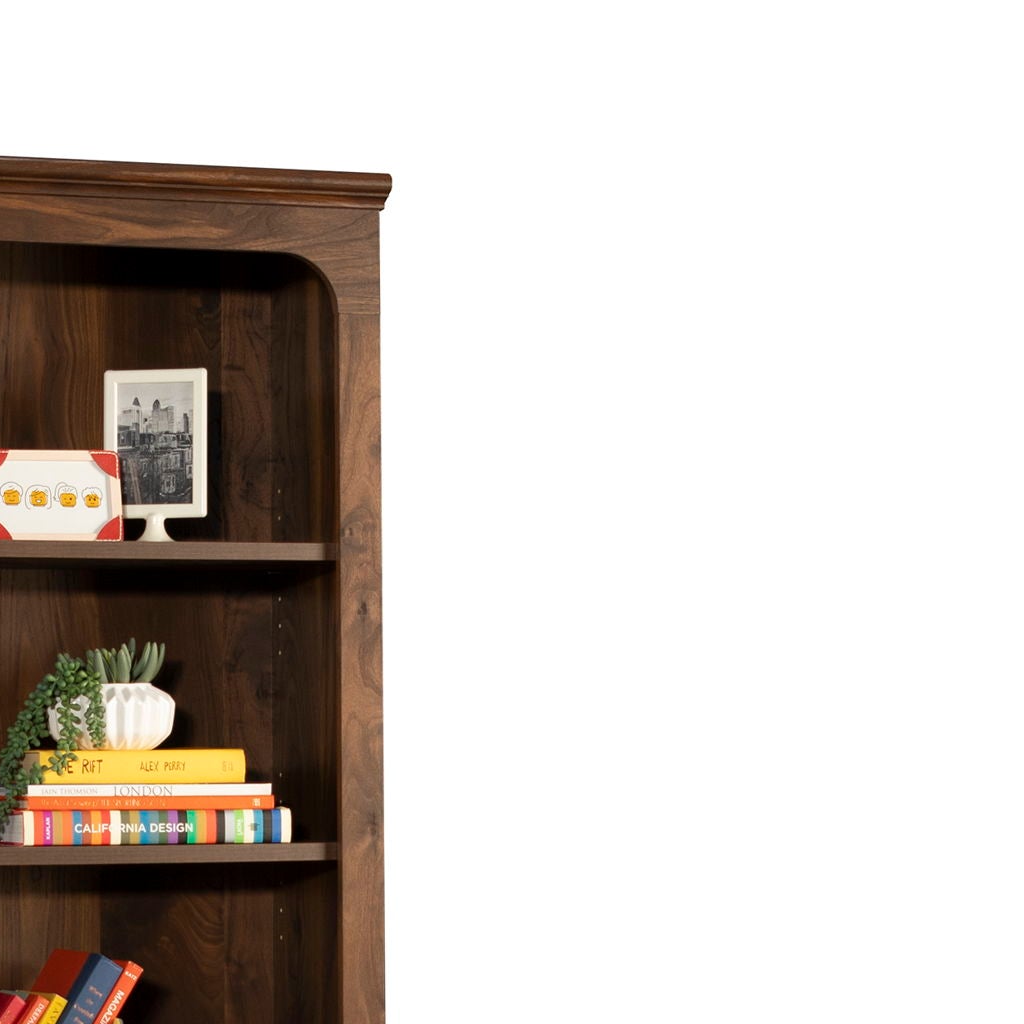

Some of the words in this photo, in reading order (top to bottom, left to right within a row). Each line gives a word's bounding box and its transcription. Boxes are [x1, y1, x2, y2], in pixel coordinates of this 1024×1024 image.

[82, 759, 103, 774] RIFT
[139, 761, 159, 772] ALEX
[164, 761, 186, 772] PERRY
[113, 785, 173, 797] LONDON
[74, 822, 147, 834] CALIFRNIA
[150, 822, 193, 833] DESIGN
